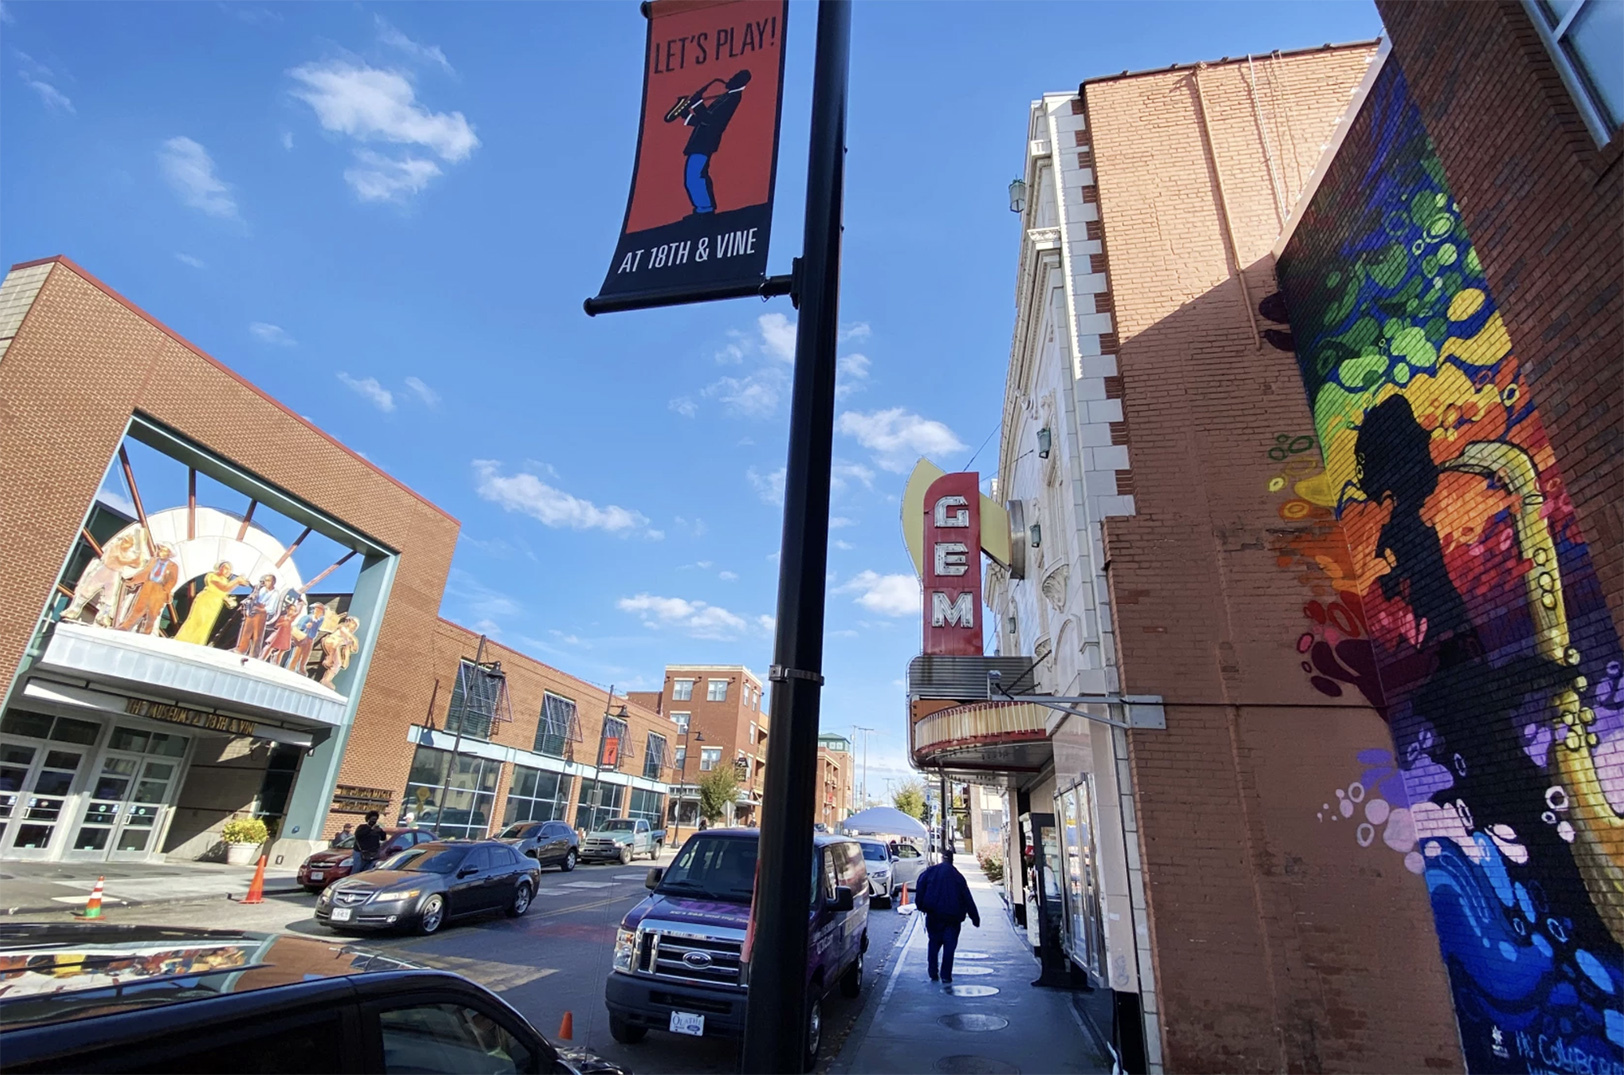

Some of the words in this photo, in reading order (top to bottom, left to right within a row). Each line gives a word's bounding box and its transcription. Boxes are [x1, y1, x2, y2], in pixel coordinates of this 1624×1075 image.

[653, 32, 708, 74] LET'S
[715, 16, 776, 61] PLAY!
[618, 248, 643, 274] AT
[648, 240, 691, 270] 18TH
[694, 237, 710, 262] &
[716, 227, 758, 258] VINE
[931, 495, 974, 628] GEM
[147, 702, 191, 725] MUSEUMS
[205, 714, 229, 731] 18TH
